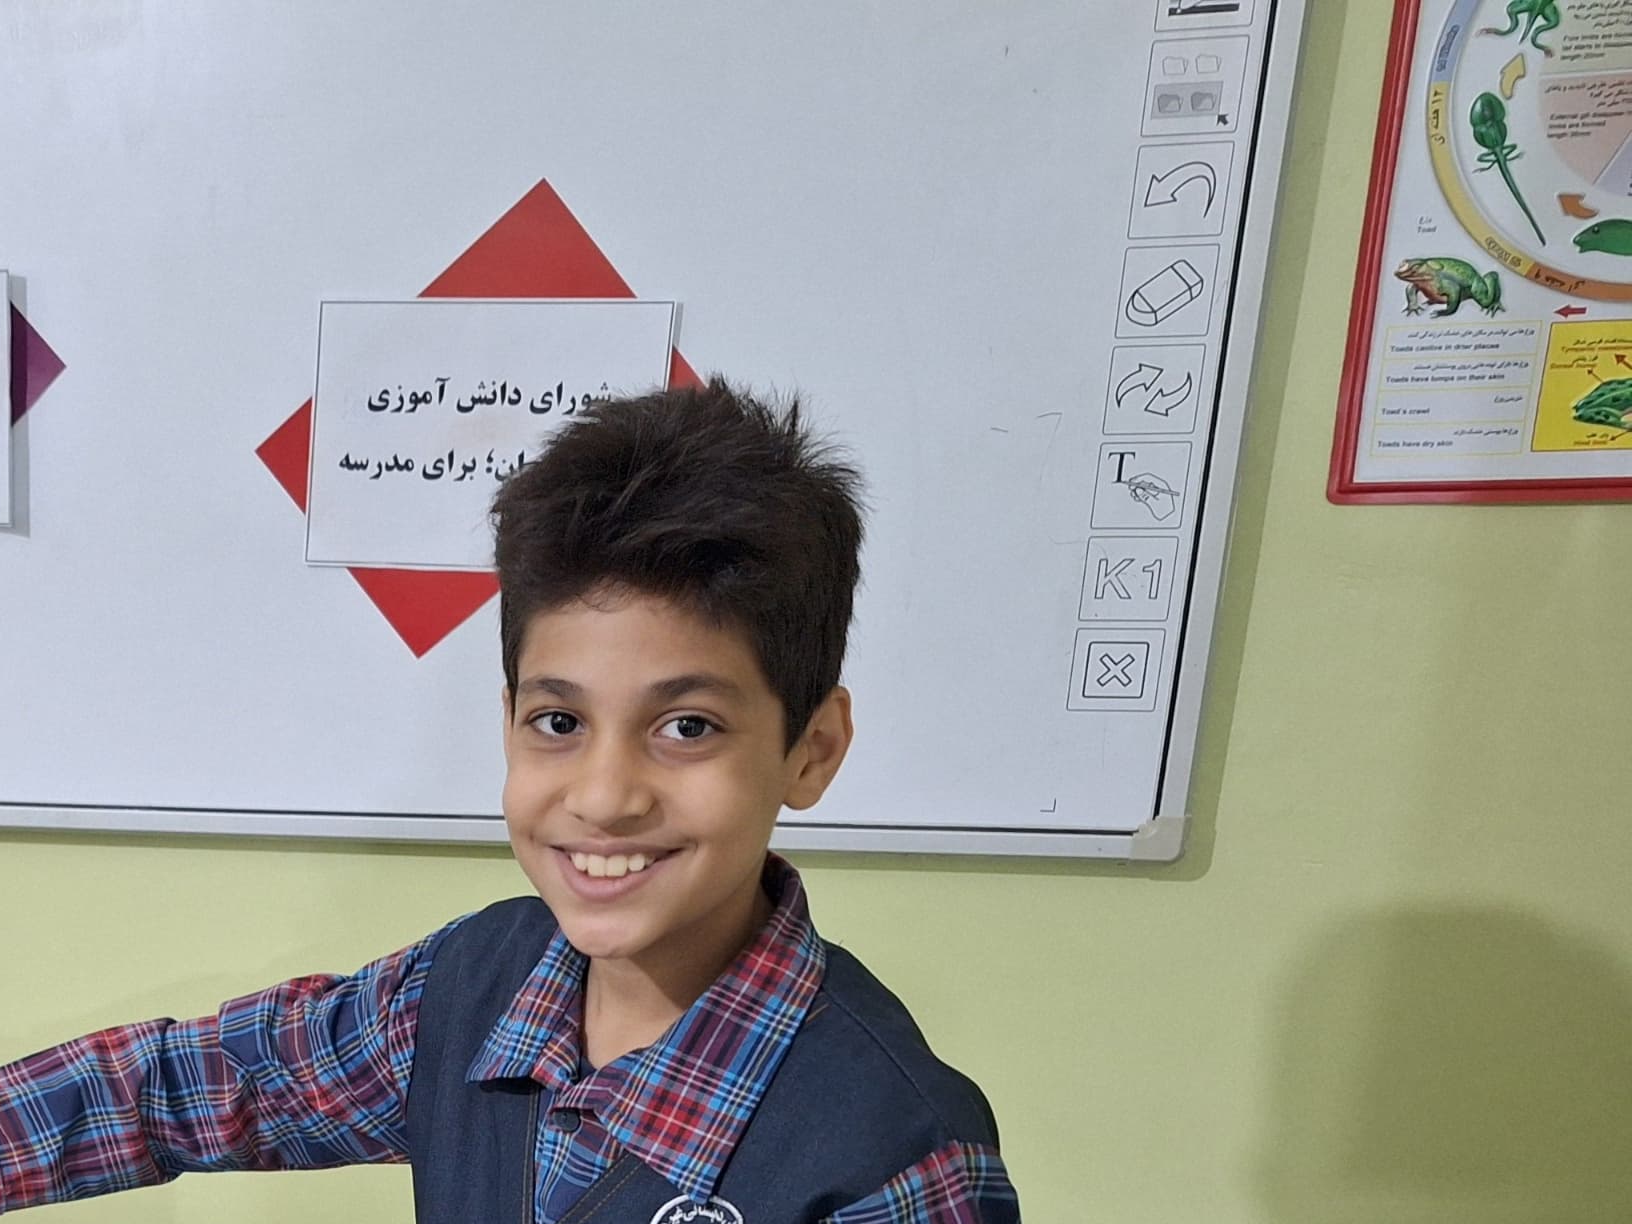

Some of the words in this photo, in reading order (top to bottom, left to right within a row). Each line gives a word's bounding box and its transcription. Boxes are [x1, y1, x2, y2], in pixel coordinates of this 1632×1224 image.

[367, 377, 451, 412] آموزی
[456, 381, 522, 414] دانش
[529, 381, 611, 414] شورای
[338, 450, 415, 482] مدرسه
[422, 449, 477, 482] برای
